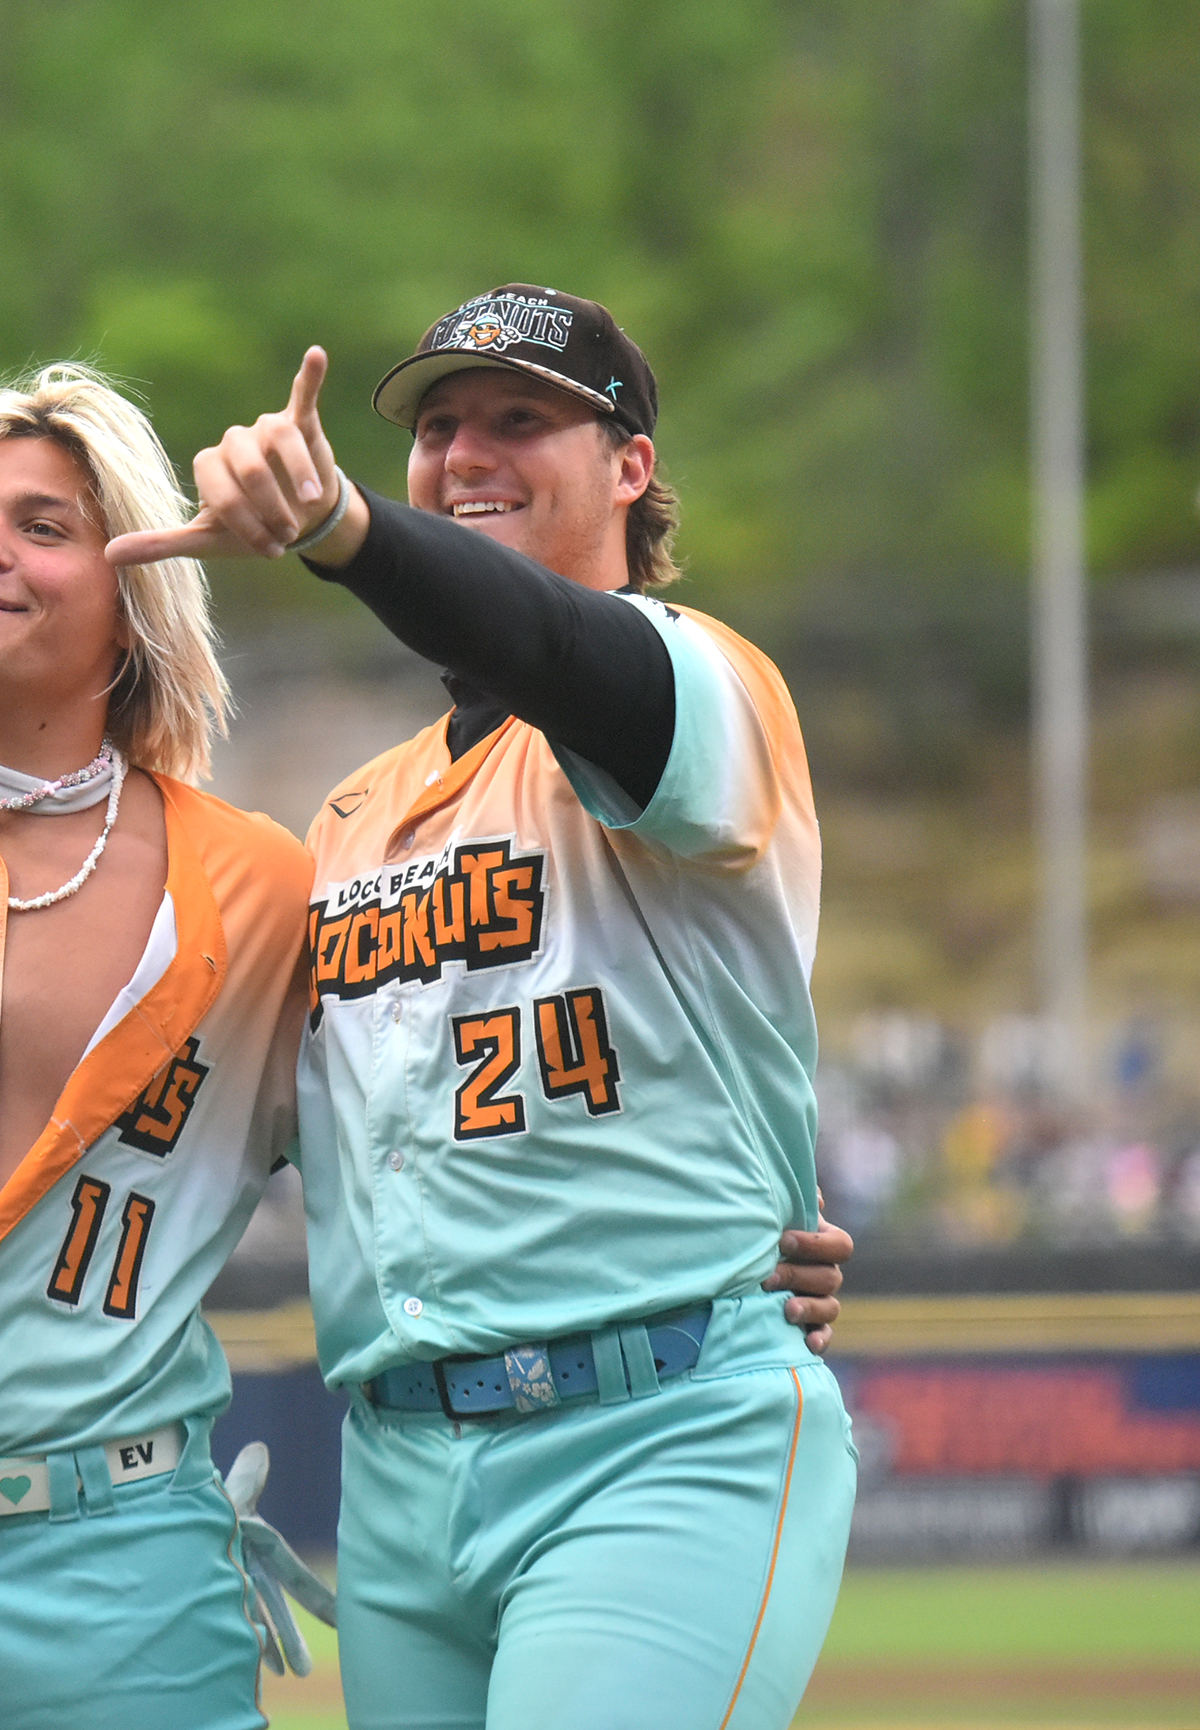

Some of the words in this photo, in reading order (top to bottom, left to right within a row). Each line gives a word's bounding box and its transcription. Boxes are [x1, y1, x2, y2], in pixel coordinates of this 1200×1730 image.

[496, 292, 548, 306] EACH
[390, 842, 453, 896] BEAH
[310, 848, 535, 1010] OCONUTS
[453, 989, 620, 1139] 24
[49, 1175, 154, 1318] 11
[119, 1441, 153, 1471] EV
